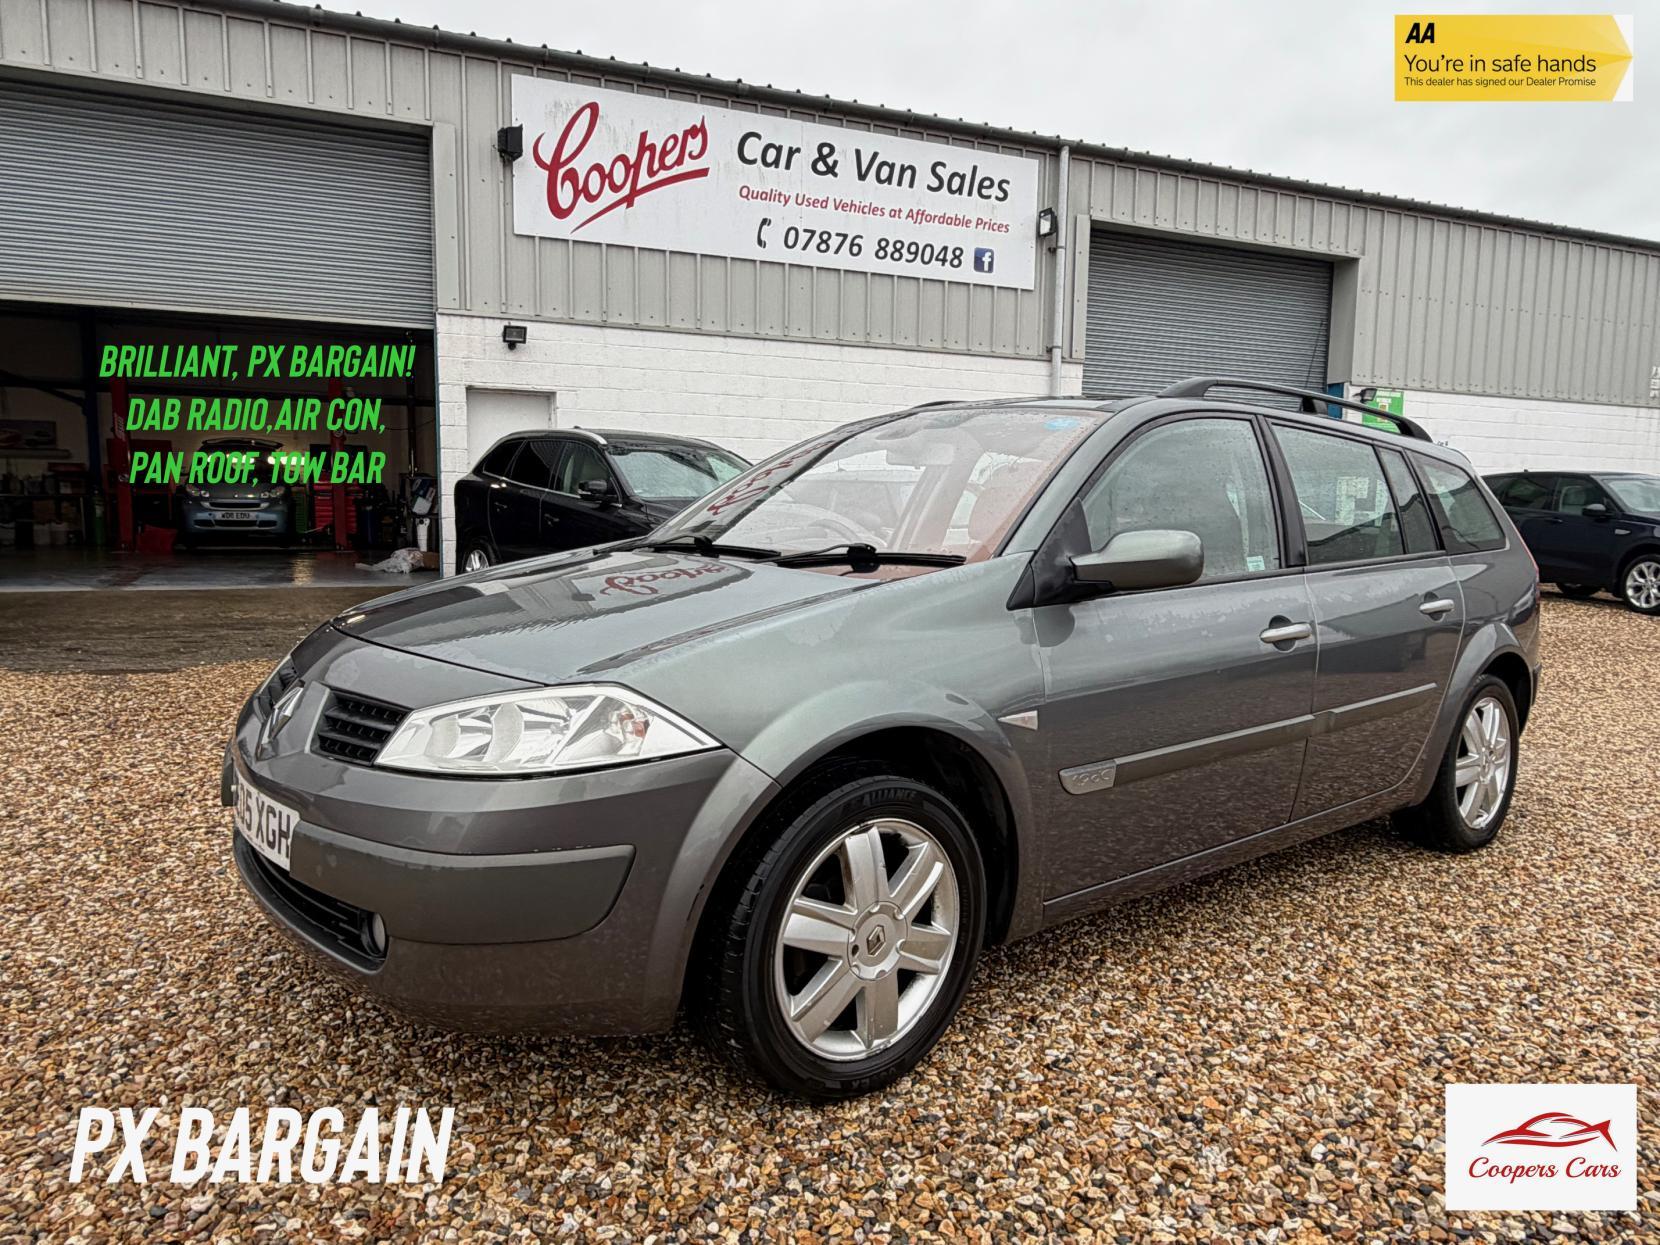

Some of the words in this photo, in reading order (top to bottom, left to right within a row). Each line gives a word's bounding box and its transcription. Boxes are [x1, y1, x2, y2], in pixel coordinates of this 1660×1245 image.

[532, 101, 710, 220] Coopers
[737, 131, 801, 171] Car
[811, 142, 839, 178] &
[854, 148, 917, 189] Van
[926, 161, 1010, 202] Sales
[738, 185, 791, 206] Quality
[795, 192, 830, 210] Used
[832, 198, 886, 219] Vehicles
[888, 206, 903, 219] at
[905, 207, 972, 230] Affordable
[975, 218, 1010, 234] Prices
[783, 226, 863, 258] 07876
[874, 237, 964, 269] 889048
[239, 782, 253, 832] 05
[255, 796, 291, 860] XGH
